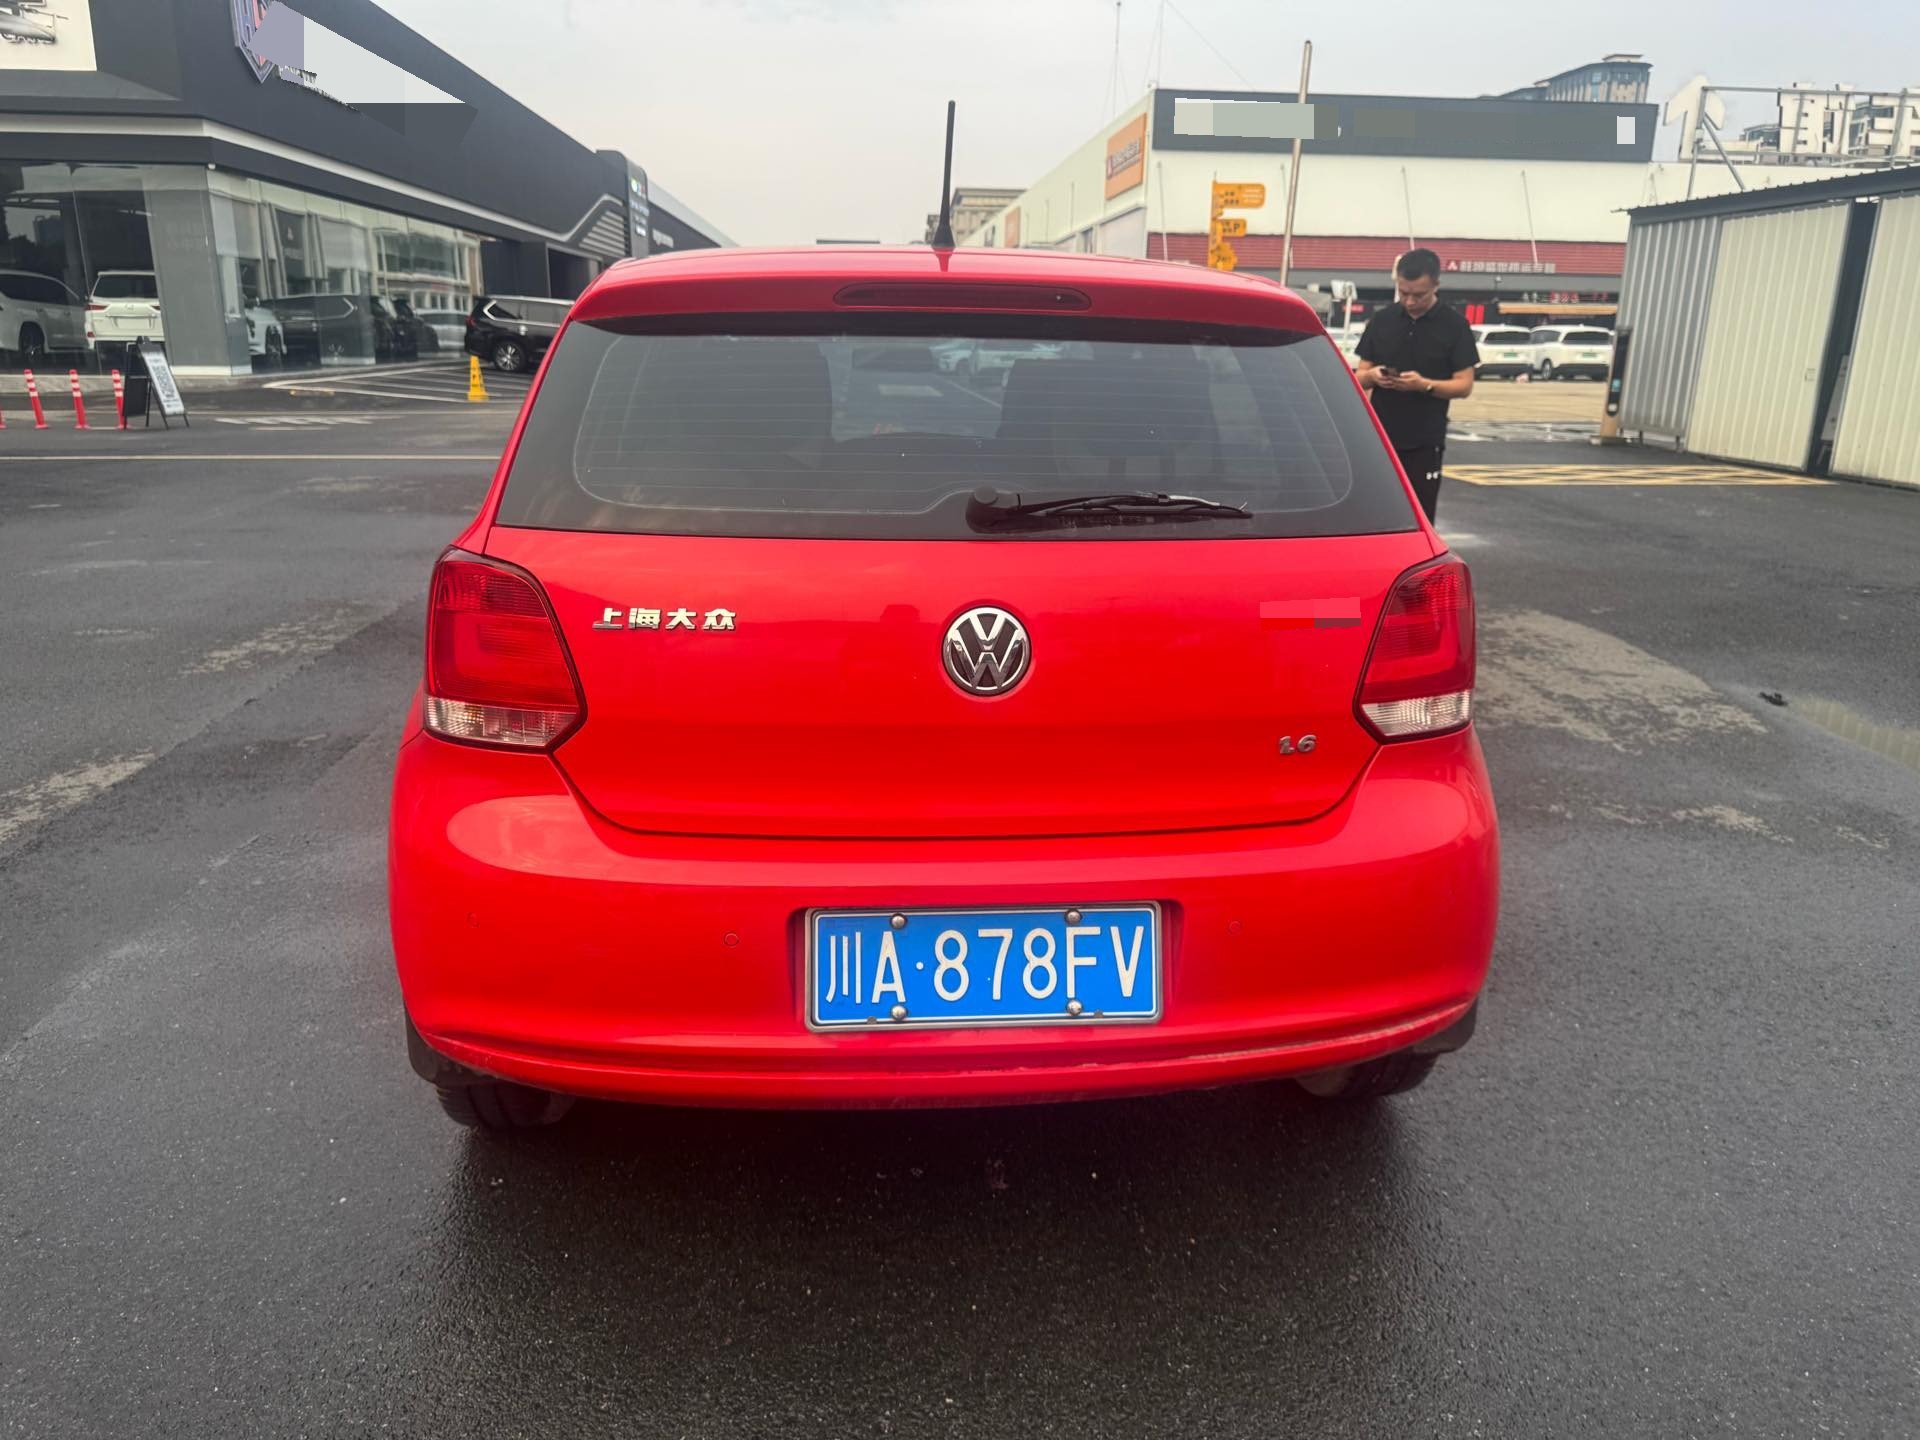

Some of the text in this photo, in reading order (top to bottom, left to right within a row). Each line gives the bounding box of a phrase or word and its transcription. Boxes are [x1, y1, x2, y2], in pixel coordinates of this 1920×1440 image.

[592, 607, 736, 630] 上海大众
[1279, 734, 1317, 755] 1.6
